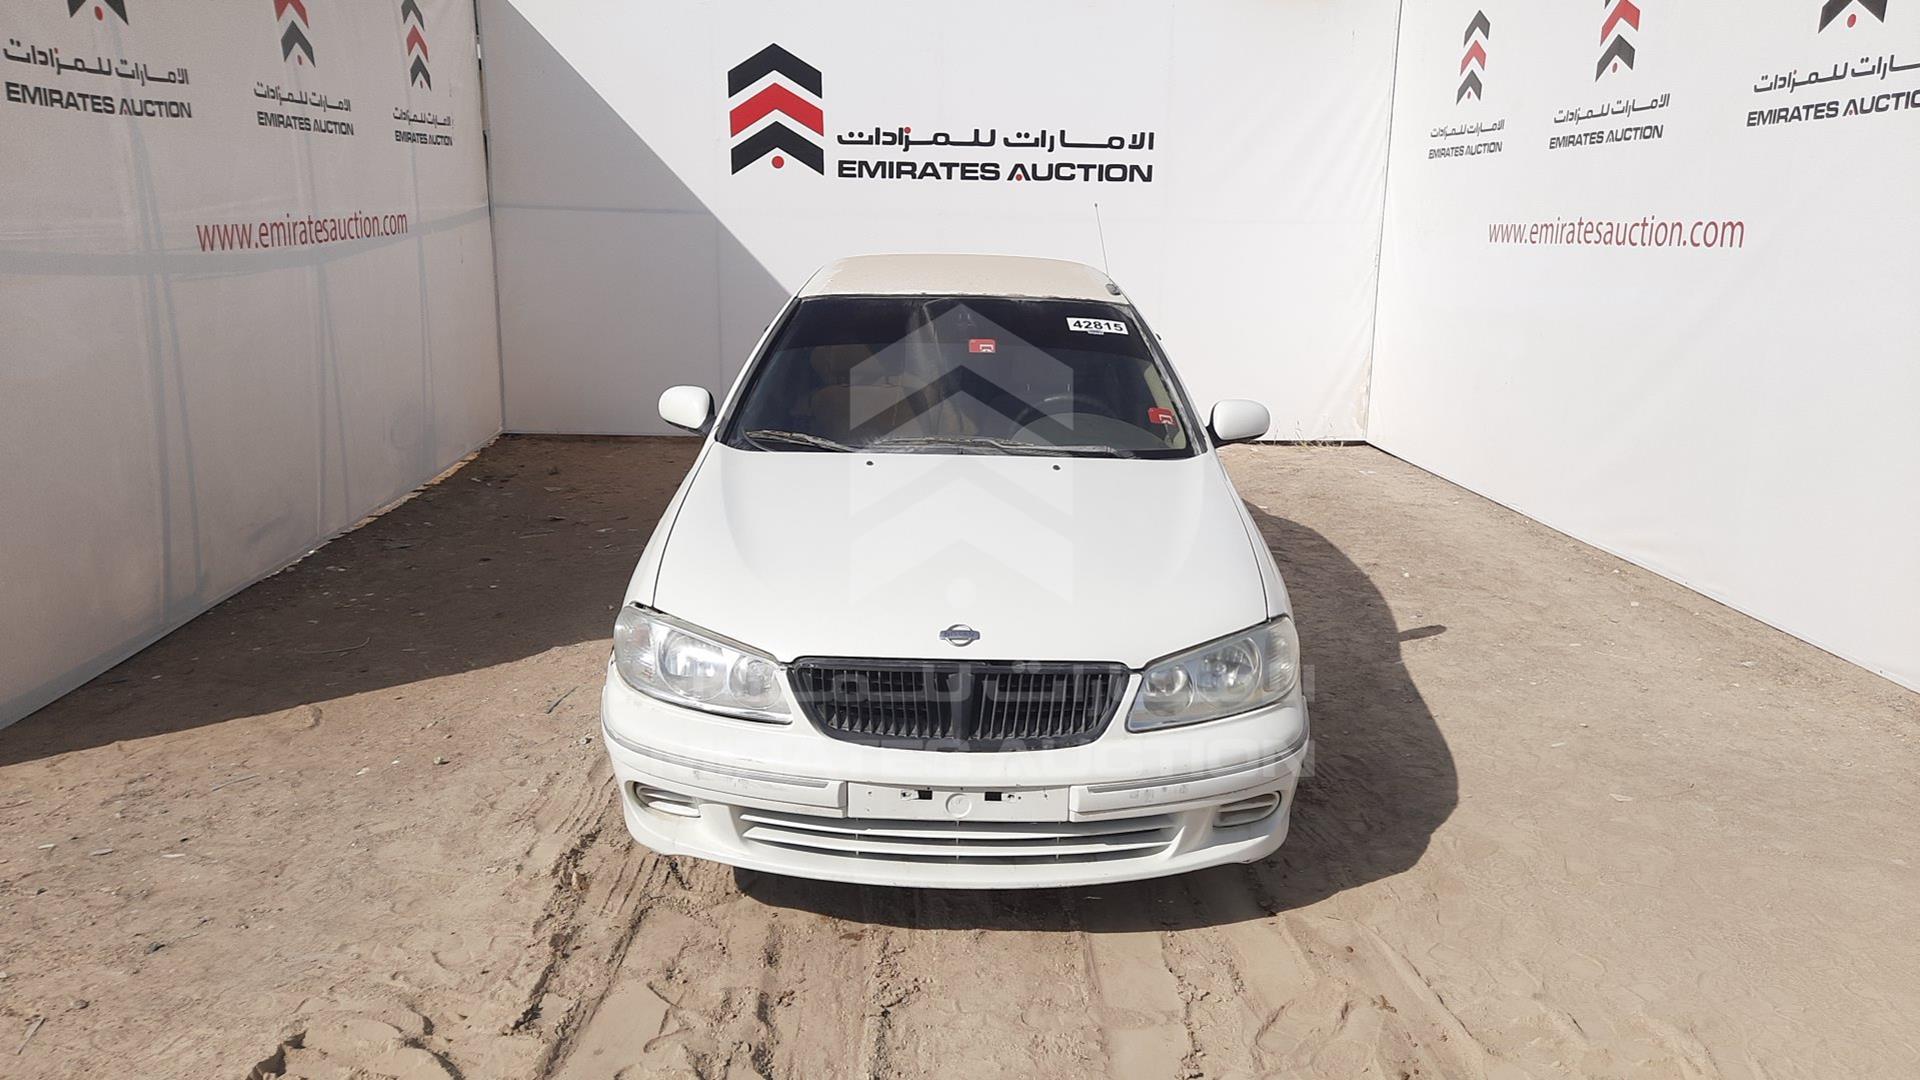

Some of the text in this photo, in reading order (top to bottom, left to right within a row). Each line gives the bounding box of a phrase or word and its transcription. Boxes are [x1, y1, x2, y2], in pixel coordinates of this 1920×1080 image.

[3, 38, 189, 86] الامارات للمزادات
[1754, 62, 1848, 93] للمزادات
[5, 81, 192, 118] EMIRATES AUCTION
[1554, 93, 1670, 125] الامارات للمزادات
[1747, 89, 1920, 127] EMIRATES AUCTIO
[257, 111, 354, 136] EMIRATES AUCTION
[1549, 125, 1664, 150] EMIRATES AUCTION
[395, 130, 453, 146] EMIRATES AUCTION
[837, 127, 1154, 152] الامارات للمزادات
[1428, 141, 1502, 159] EMIRATES AUCTION
[838, 160, 1153, 182] EMIRATES AUCTION
[196, 211, 408, 252] www.emiratesauction.com
[1488, 214, 1745, 248] www.emiratesauction.com
[1072, 319, 1124, 332] 42815
